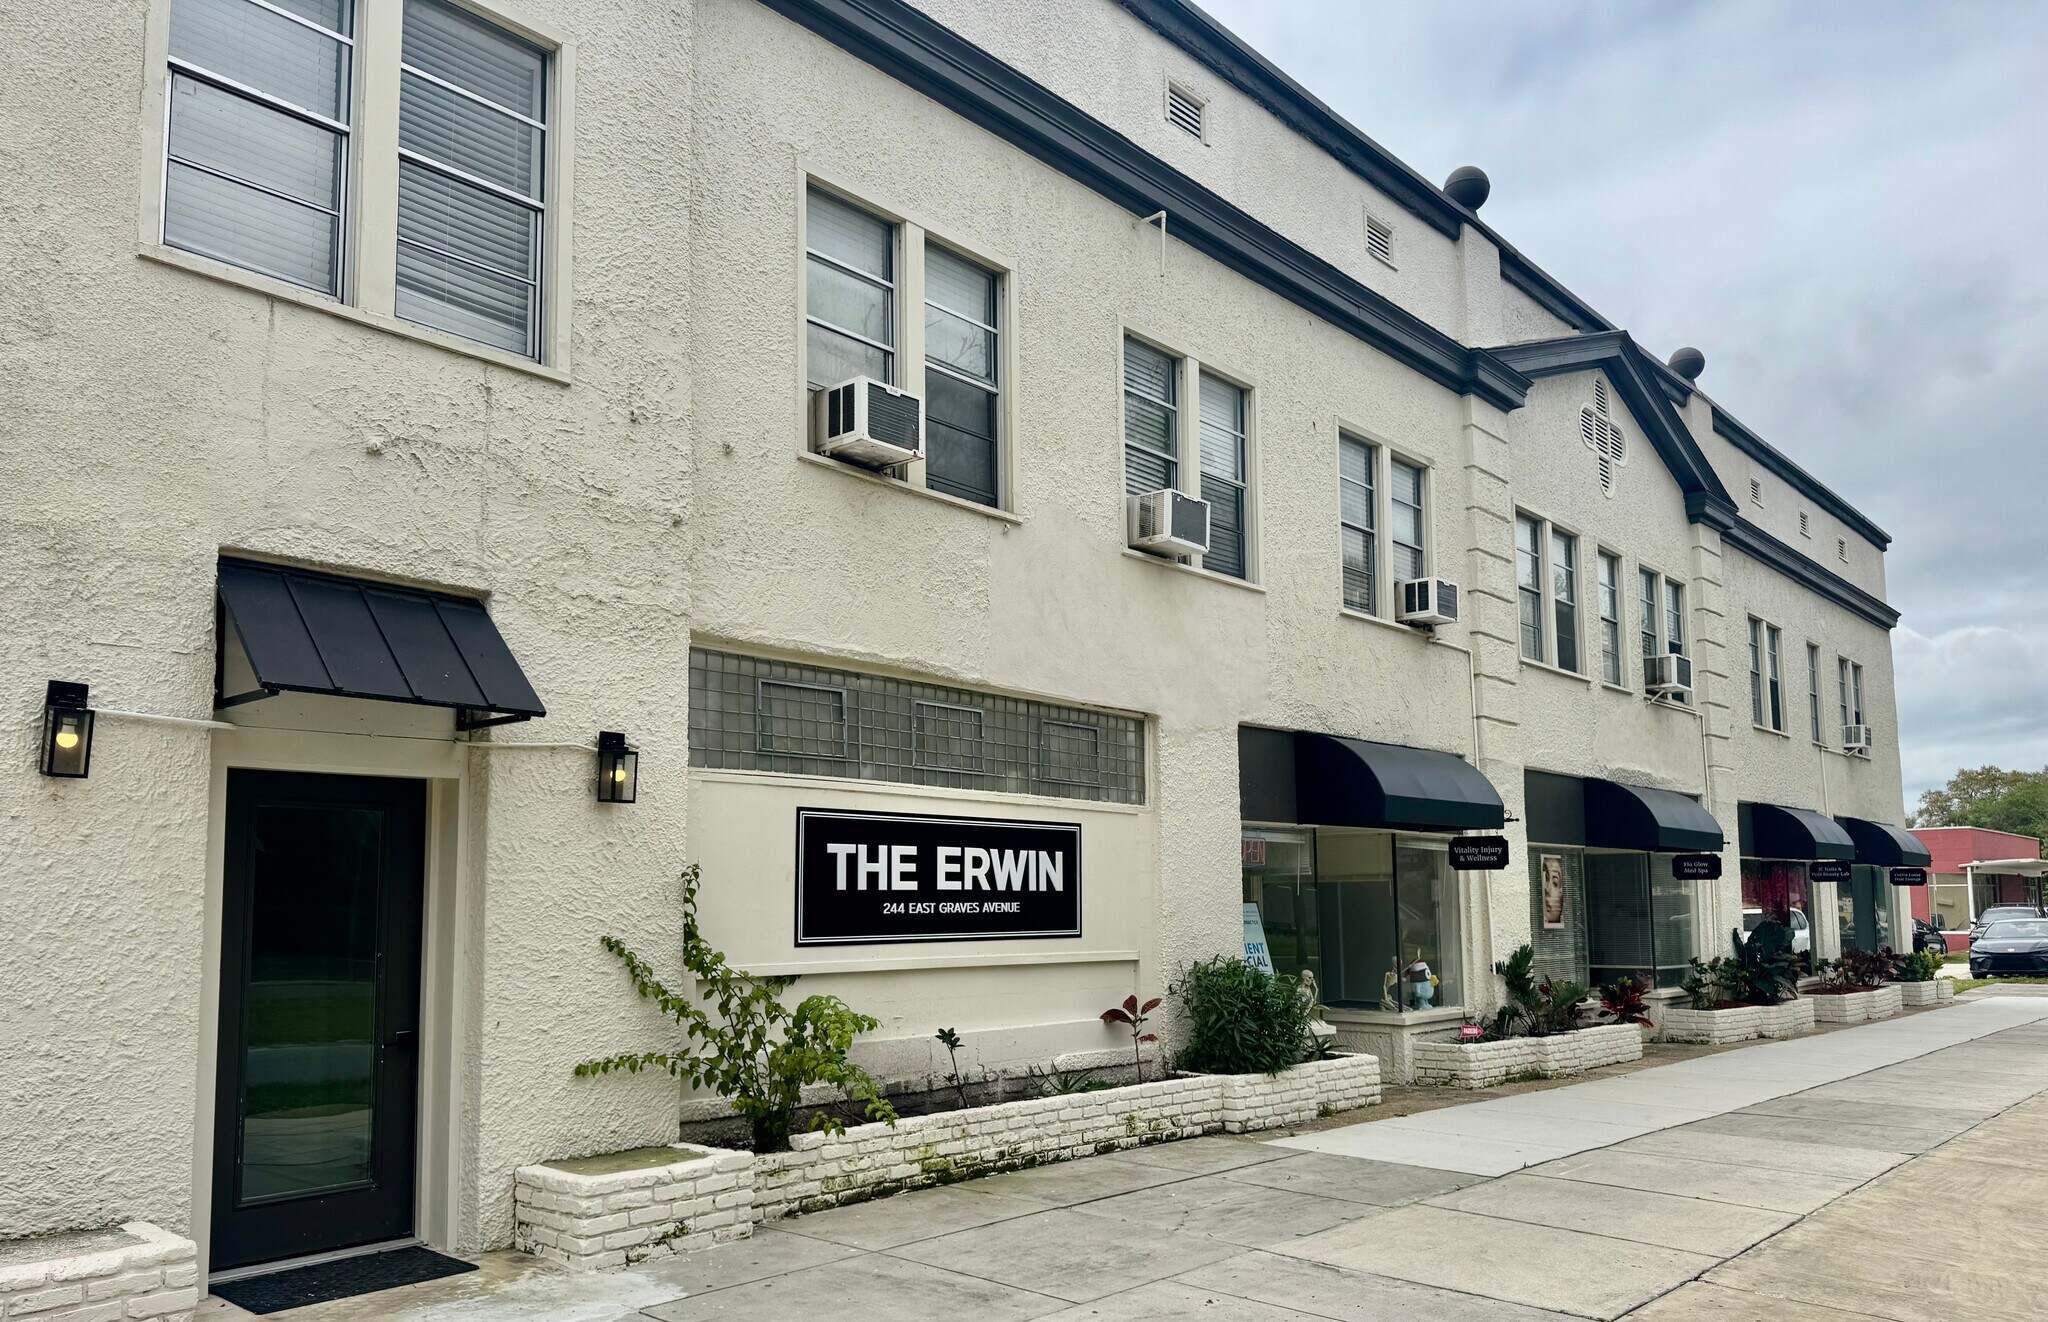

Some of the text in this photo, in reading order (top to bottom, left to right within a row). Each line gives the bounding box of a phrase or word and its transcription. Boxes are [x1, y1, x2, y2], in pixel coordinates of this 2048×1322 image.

[1453, 846, 1502, 854] Vitality Injury
[827, 843, 1064, 892] THE ERWIN
[1697, 867, 1709, 875] Spa
[883, 902, 1020, 915] 244 EAST GRAVES AVENUE
[1244, 942, 1265, 955] IENT
[1246, 955, 1269, 968] CIAL
